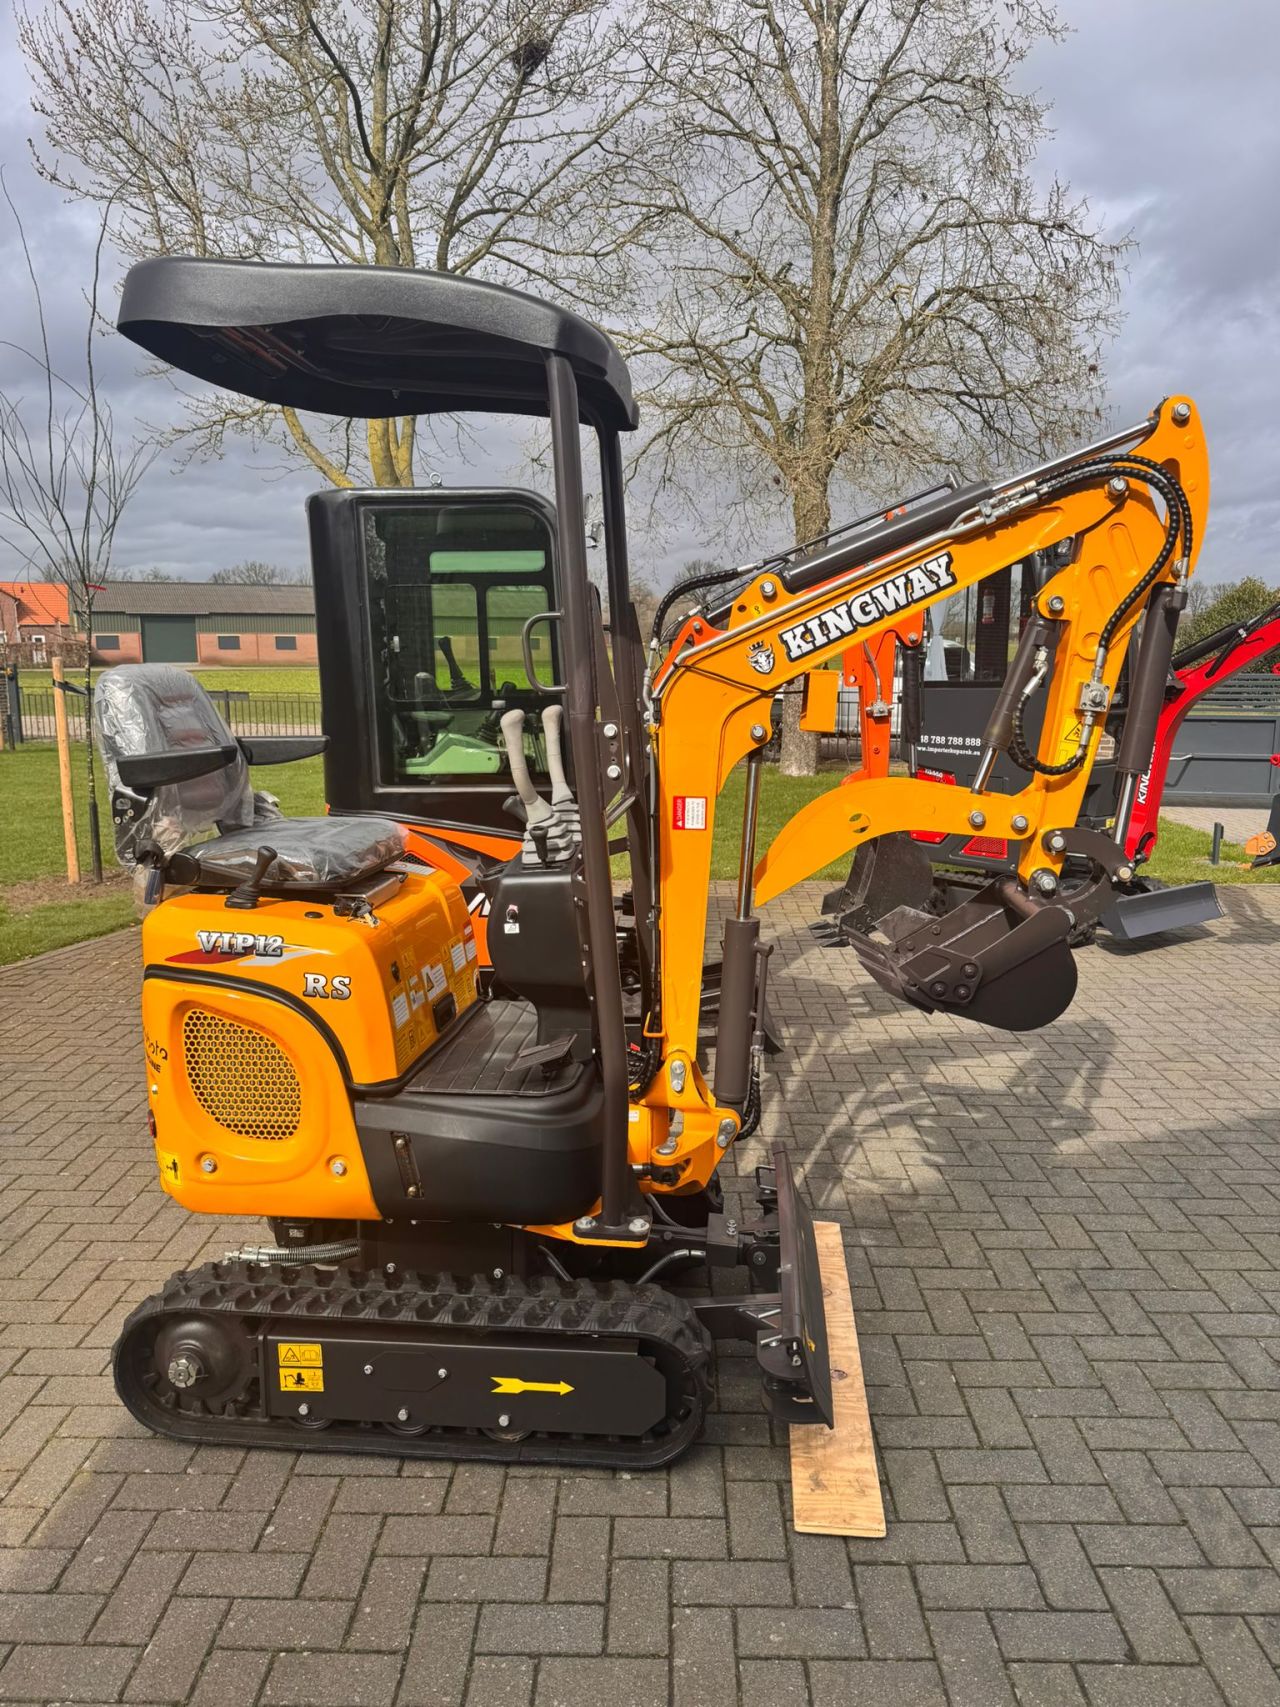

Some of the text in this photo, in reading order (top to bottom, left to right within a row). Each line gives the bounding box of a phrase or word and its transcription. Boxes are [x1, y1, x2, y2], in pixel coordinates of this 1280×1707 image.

[779, 551, 957, 662] KINGWAY
[931, 735, 946, 744] 788
[948, 736, 963, 746] 788
[965, 738, 981, 747] 888
[197, 931, 284, 957] VIP12
[303, 973, 352, 1001] RS
